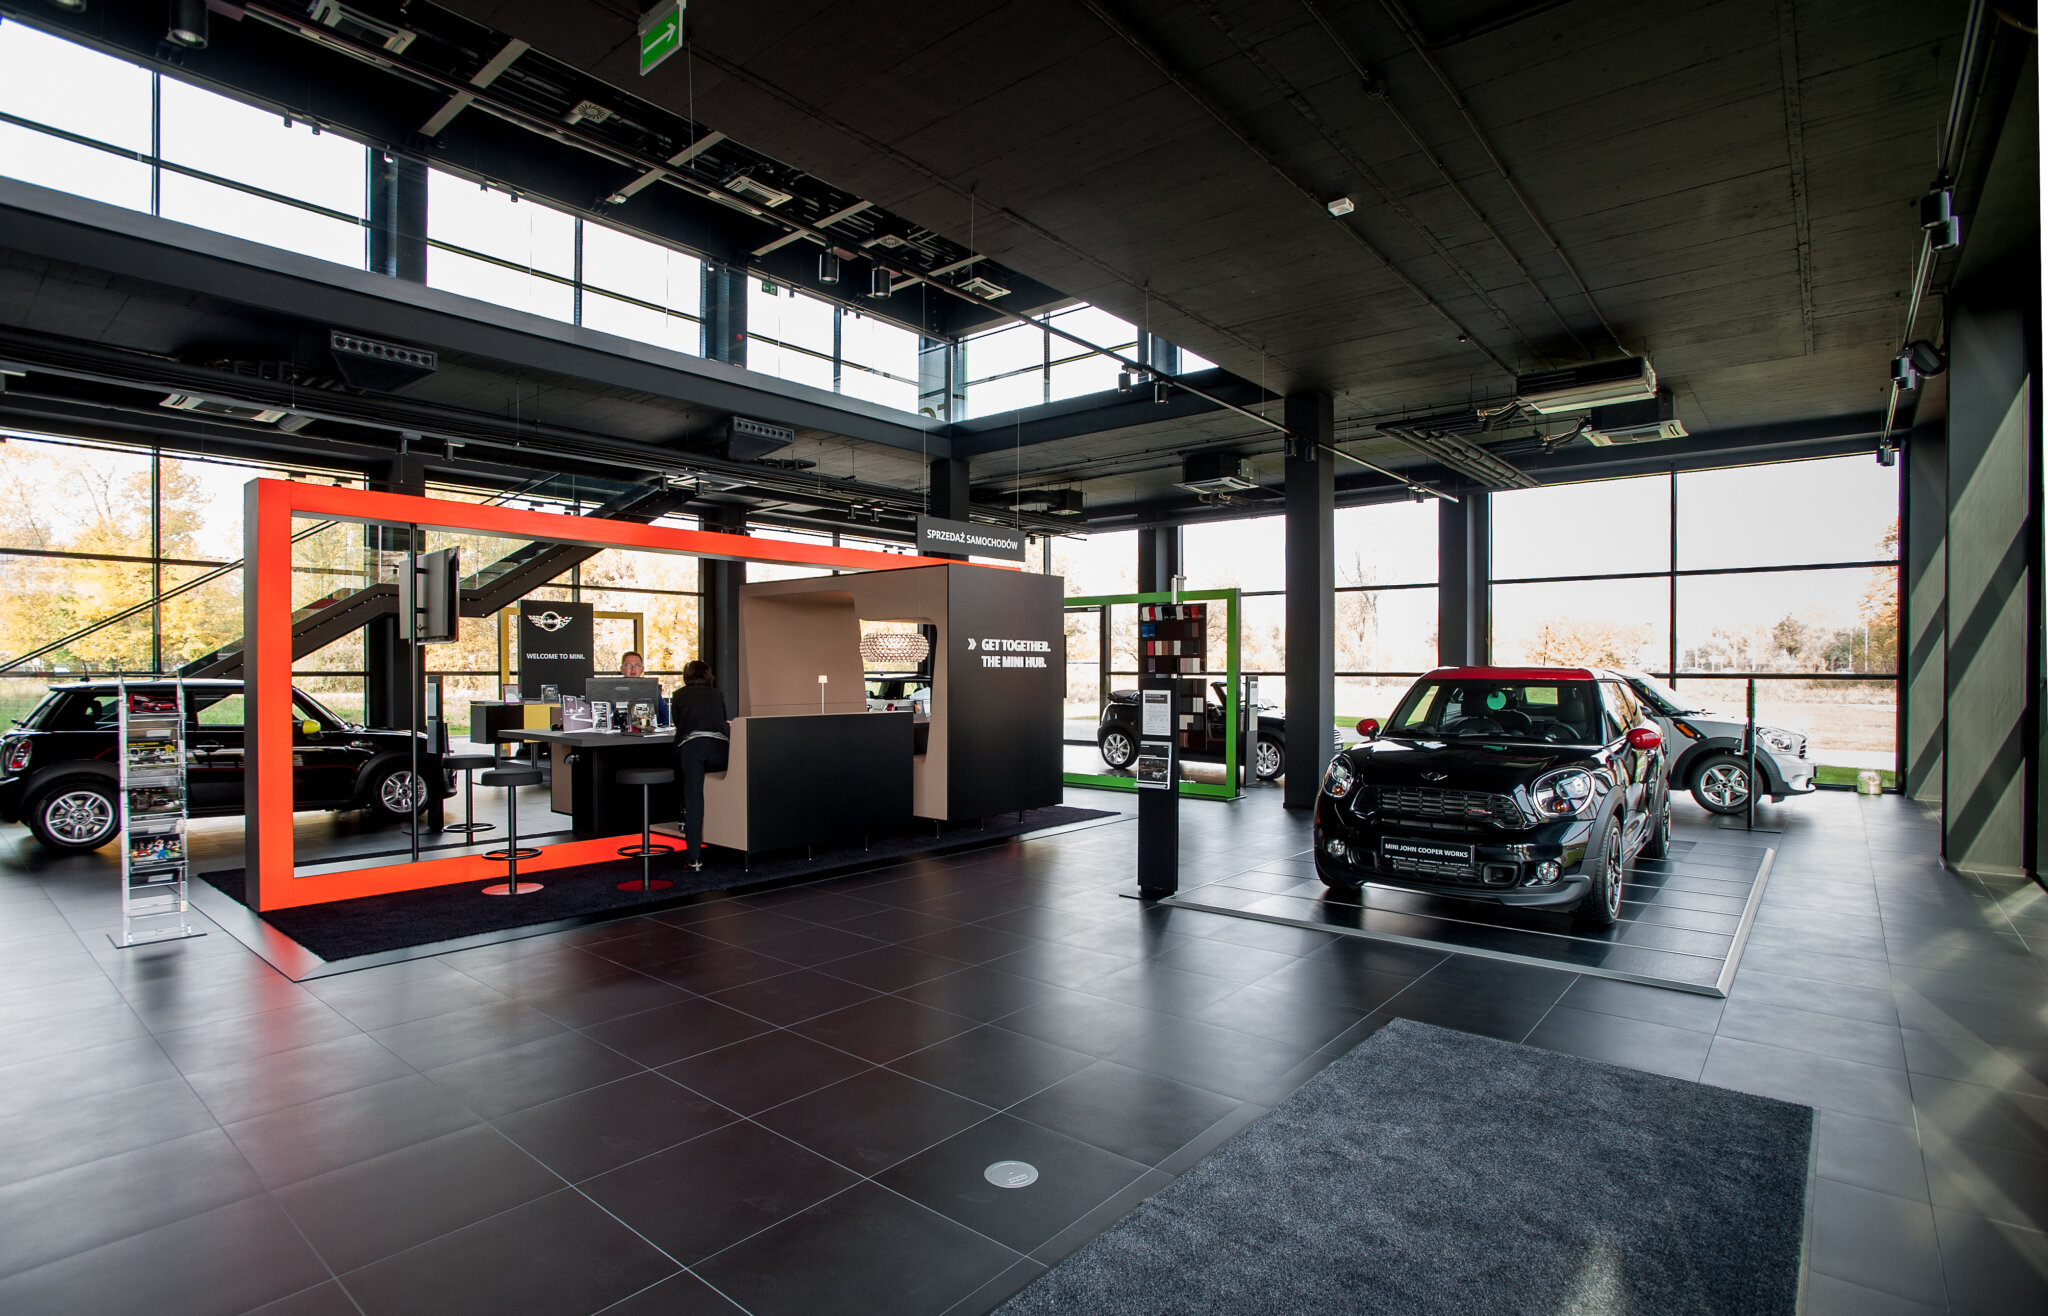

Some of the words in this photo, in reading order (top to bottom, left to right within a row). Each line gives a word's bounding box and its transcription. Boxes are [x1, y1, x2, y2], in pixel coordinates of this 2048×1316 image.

[926, 529, 966, 543] SPRZEDAŻ
[966, 534, 1018, 550] SAMOCHODÓW
[981, 639, 1001, 651] GET
[1001, 639, 1051, 652] TOGETHER.
[981, 655, 1001, 668] THE
[1002, 656, 1024, 668] MINI
[1025, 656, 1047, 668] HUB.
[1399, 845, 1417, 853] JOHN
[1417, 847, 1444, 855] COOPER
[1444, 850, 1469, 858] WORKS
